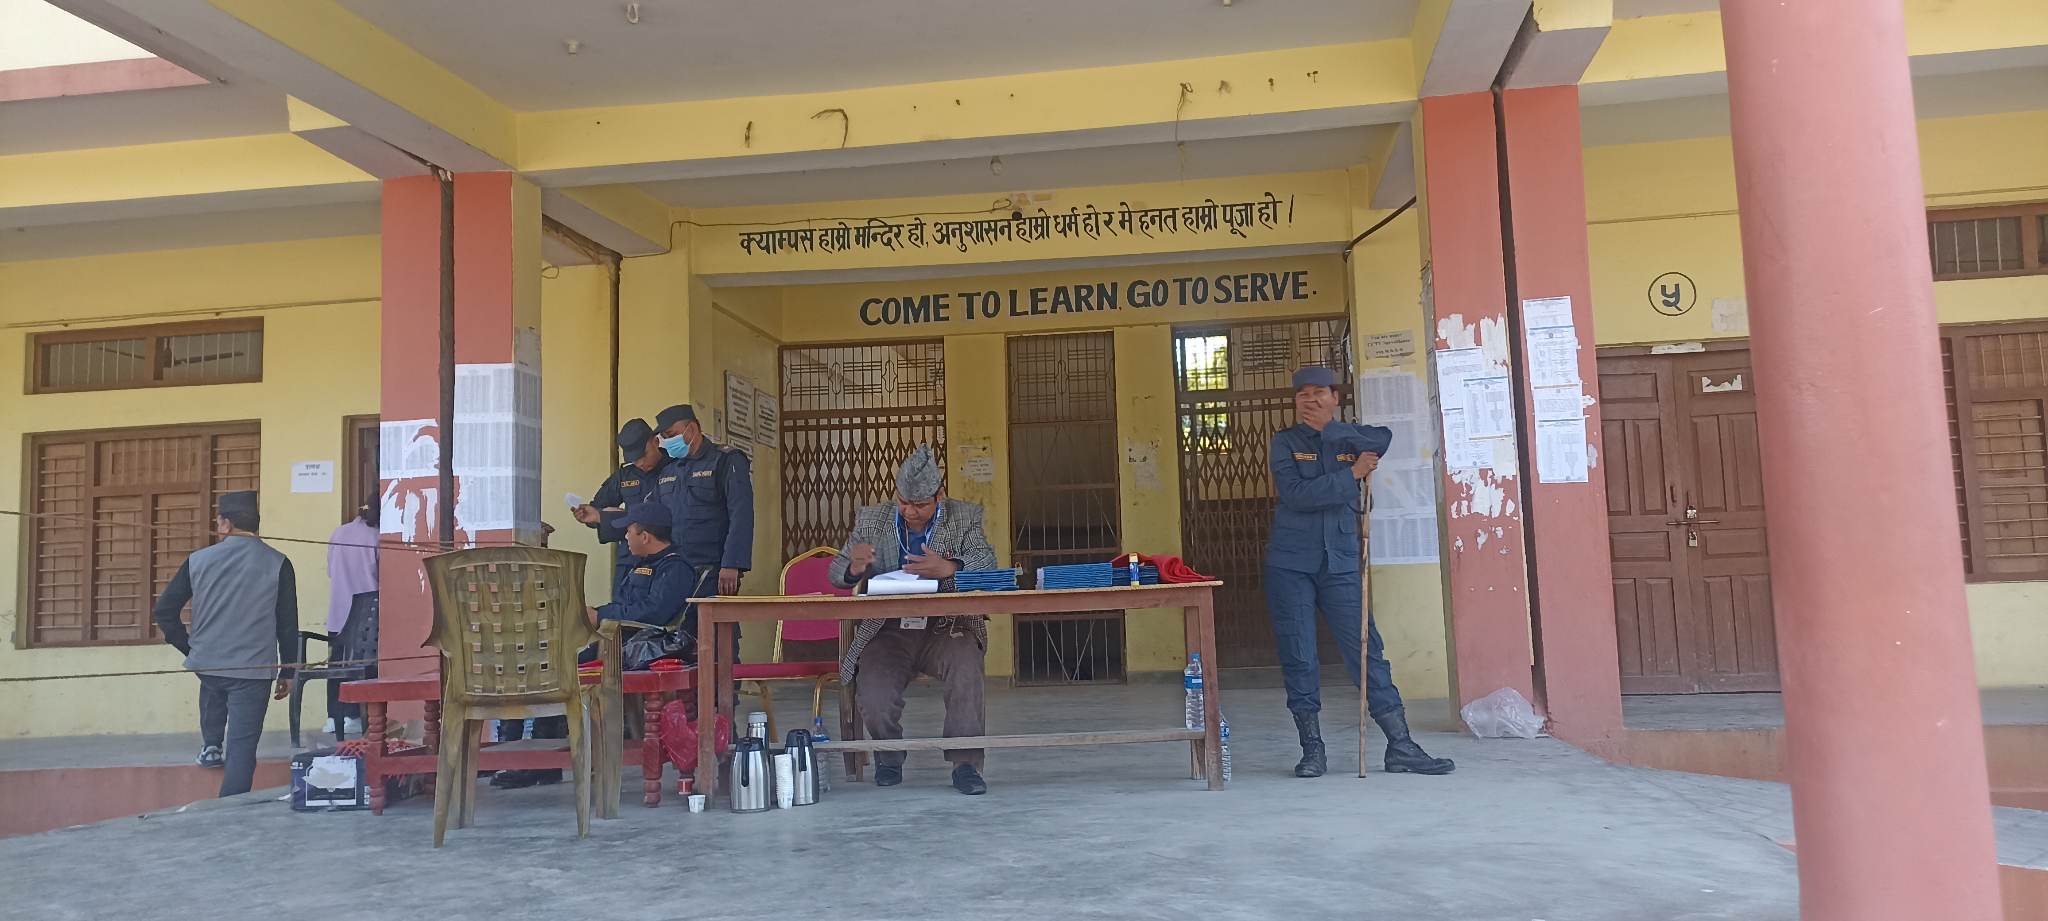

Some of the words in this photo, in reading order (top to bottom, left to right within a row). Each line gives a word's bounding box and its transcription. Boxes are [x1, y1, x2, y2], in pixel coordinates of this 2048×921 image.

[854, 218, 904, 252] मन्दिर
[932, 219, 1012, 253] अनुशासन
[1053, 207, 1080, 238] धर्म
[1221, 203, 1255, 238] पूजा
[859, 294, 949, 326] COME
[957, 290, 1001, 320] TO
[1126, 279, 1169, 308] GO
[1172, 277, 1213, 306] TO
